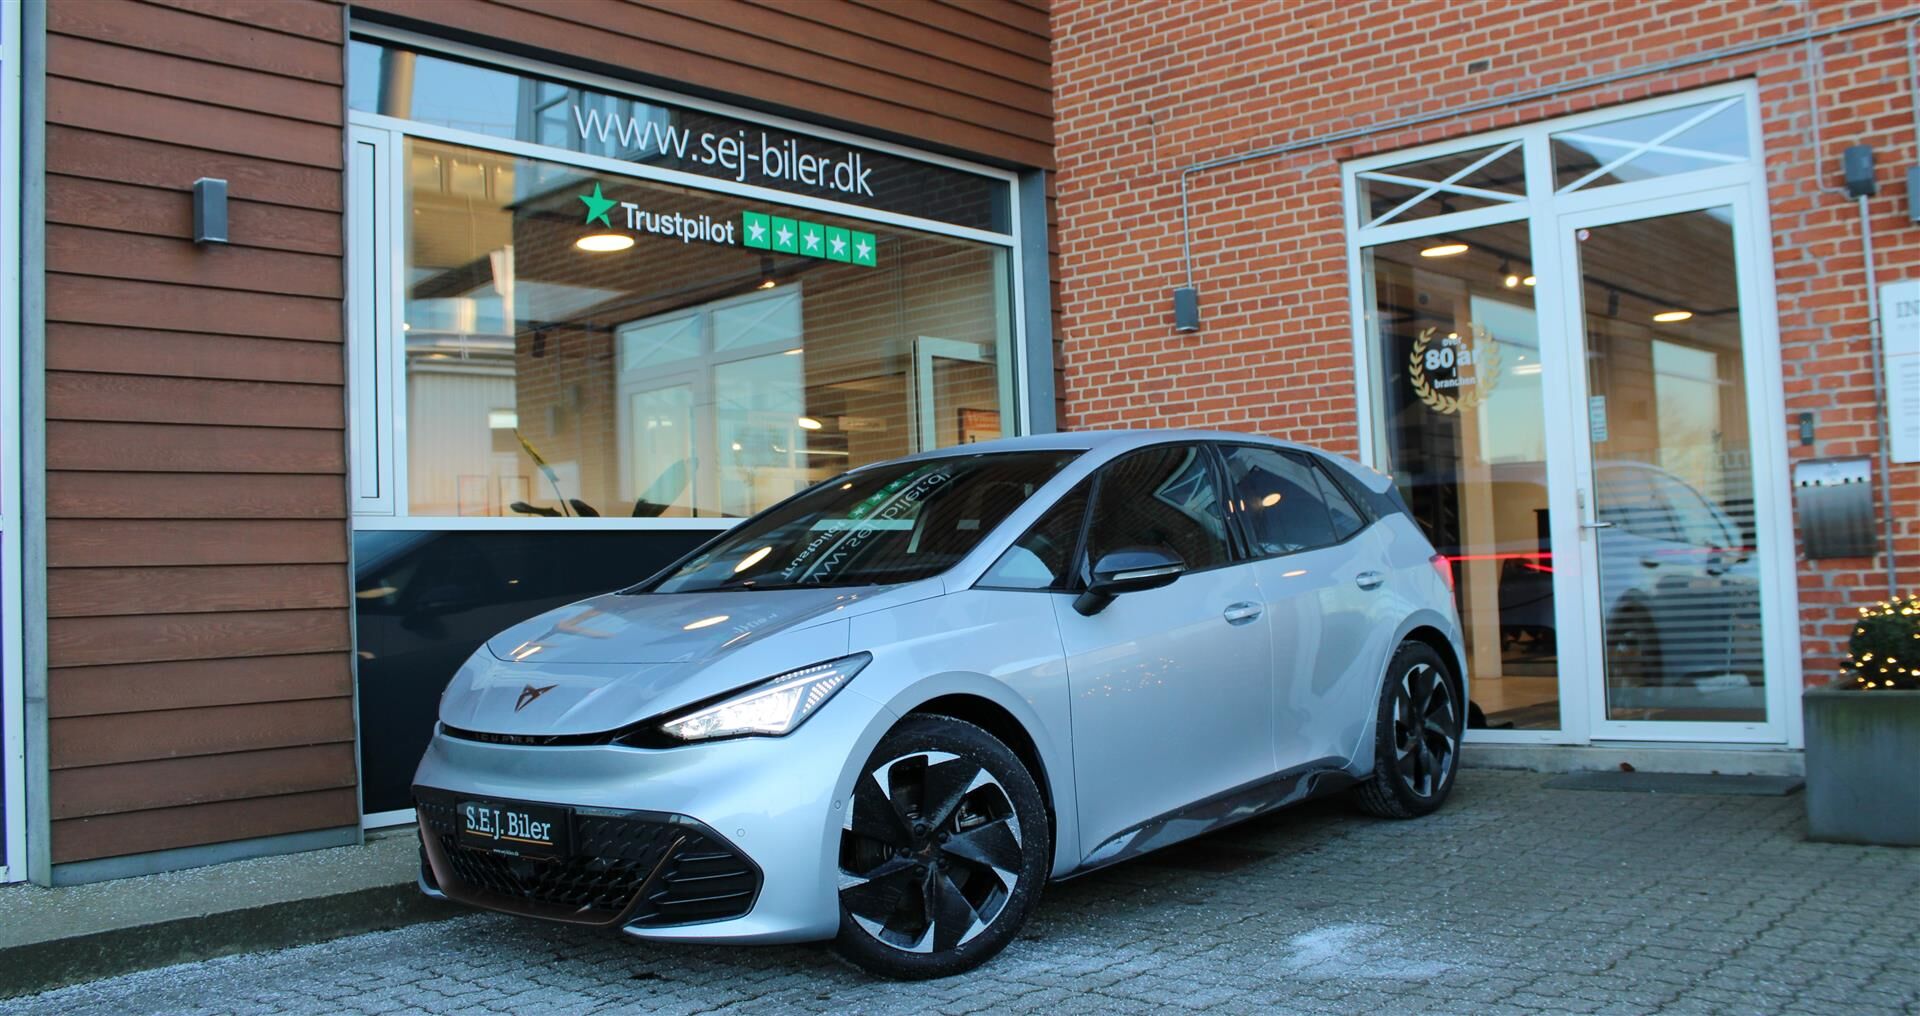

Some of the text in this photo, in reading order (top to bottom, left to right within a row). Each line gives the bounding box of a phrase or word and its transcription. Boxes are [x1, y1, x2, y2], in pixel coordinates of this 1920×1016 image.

[573, 104, 874, 197] www.sej-biler.dk
[620, 201, 736, 246] Trustpilot
[1425, 347, 1454, 370] 80
[466, 806, 551, 840] S.E.J. Biler
